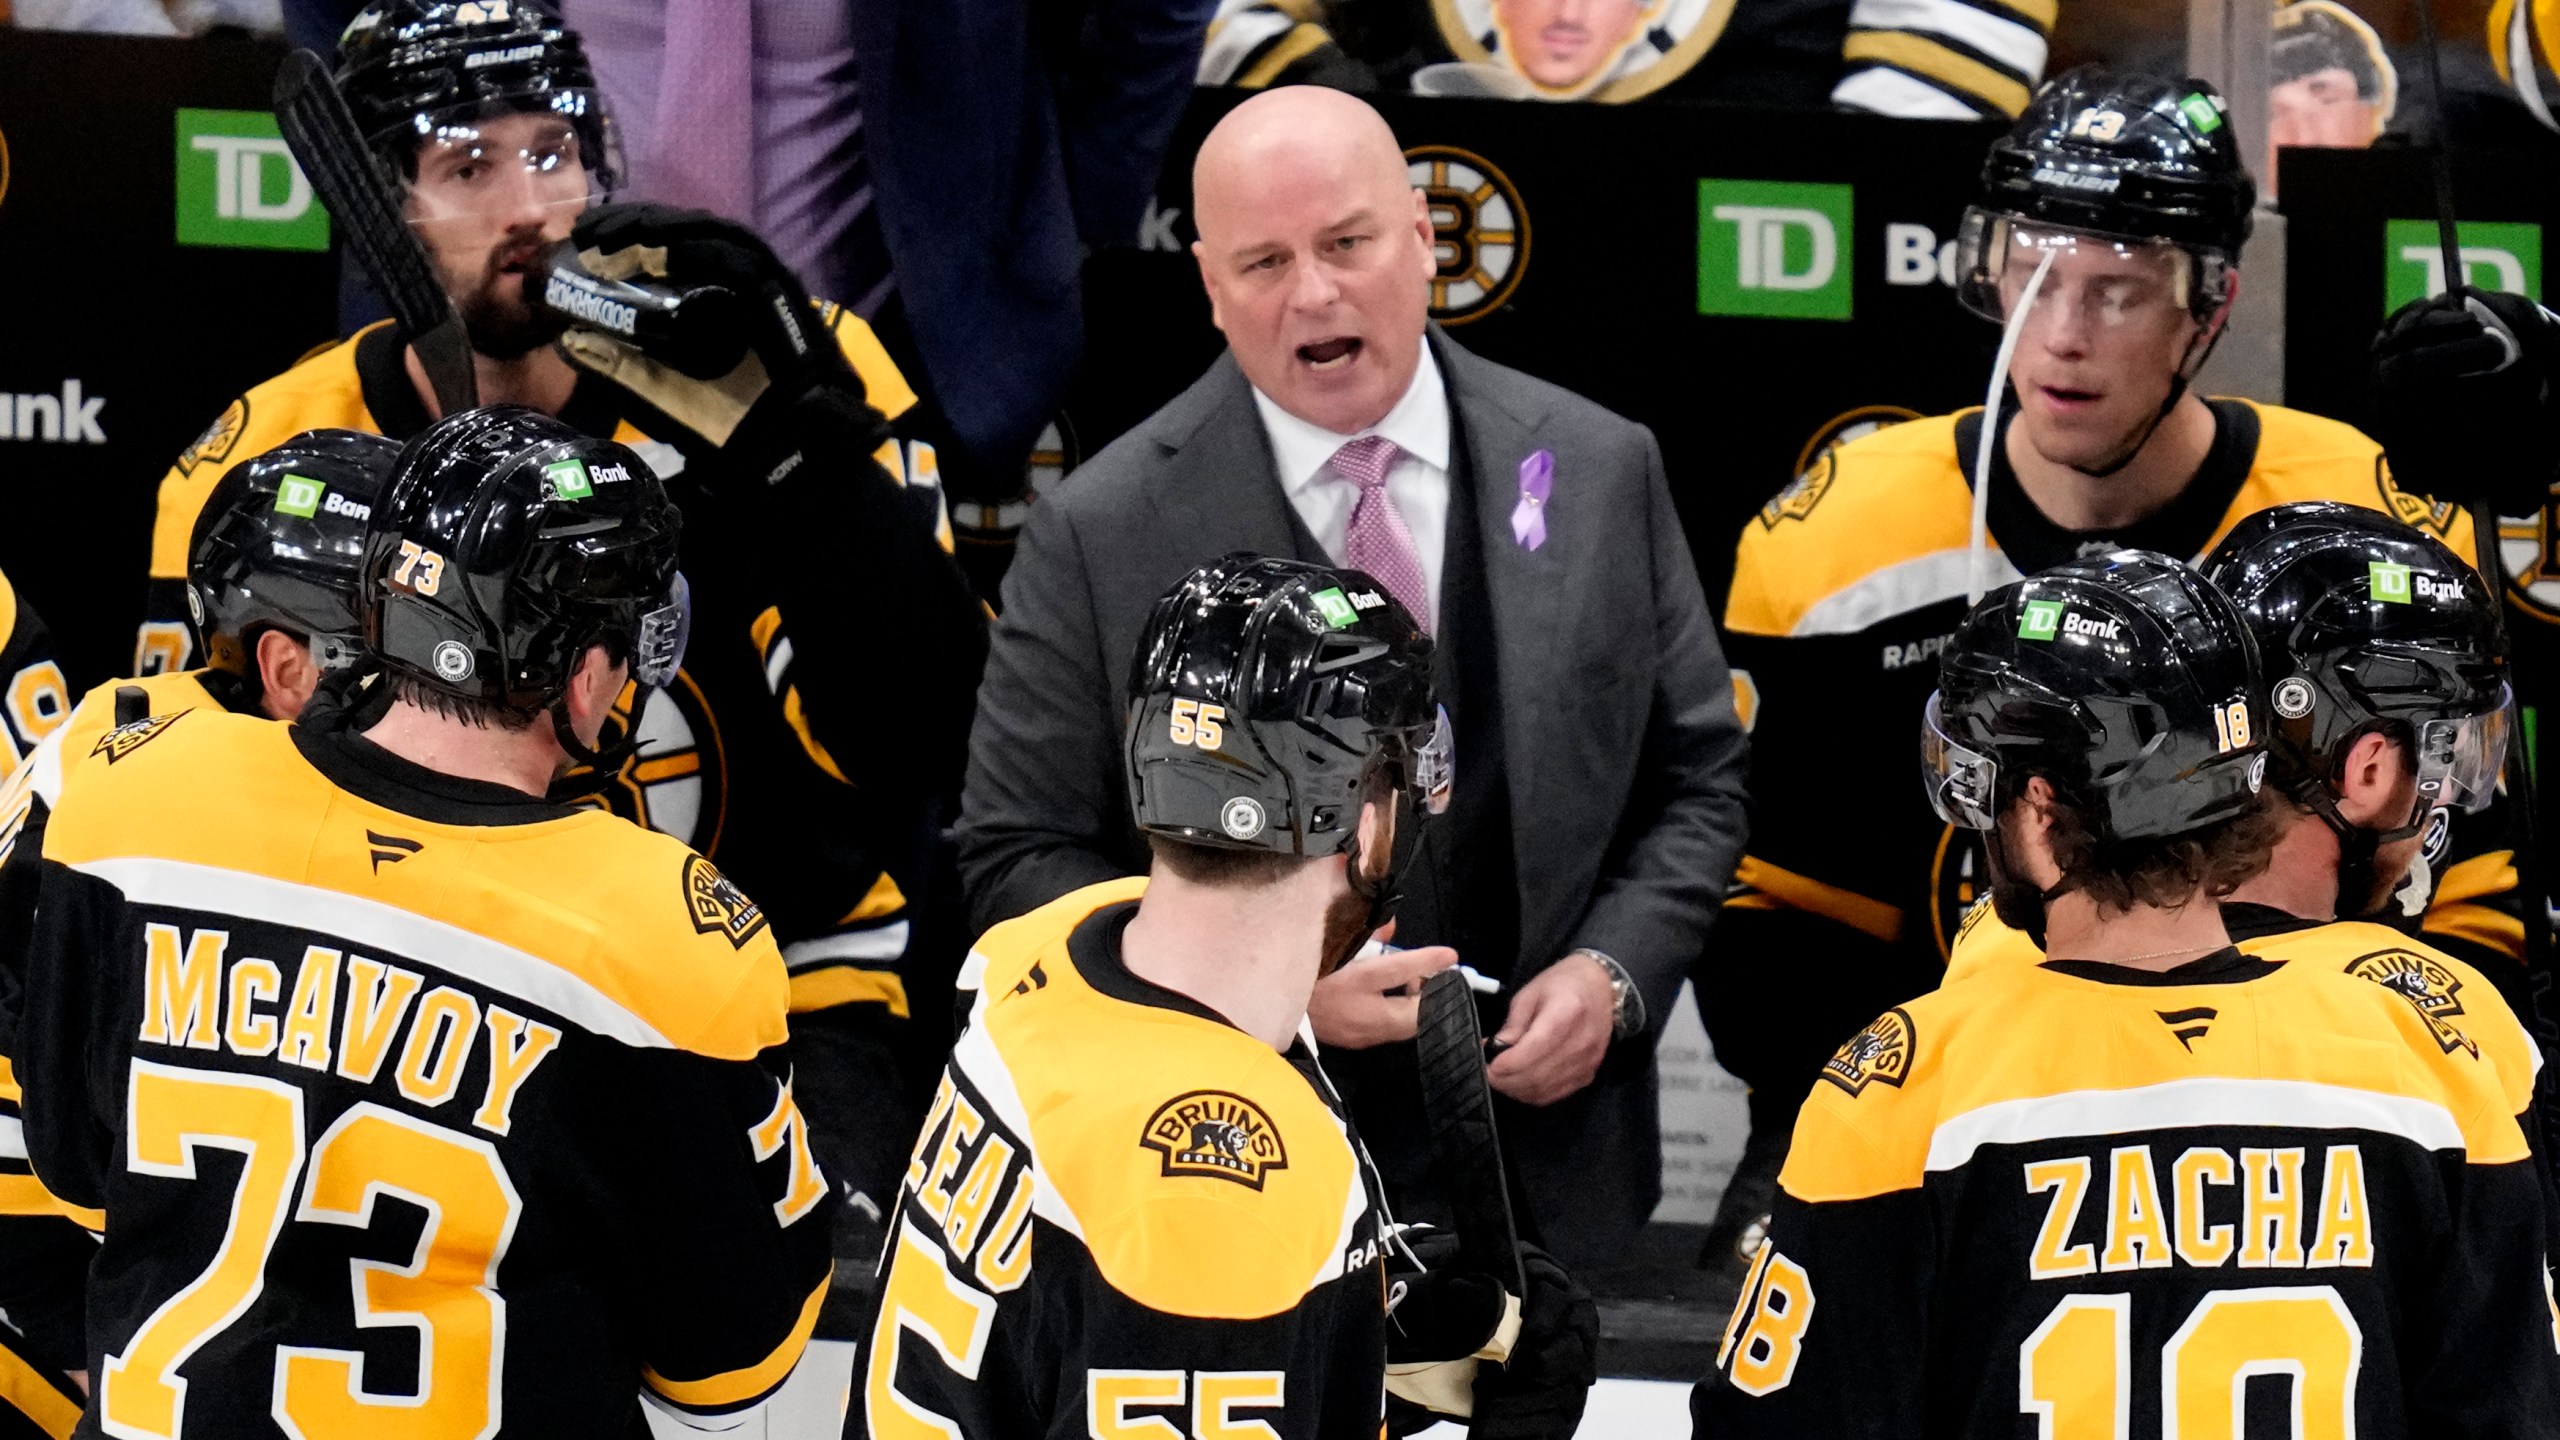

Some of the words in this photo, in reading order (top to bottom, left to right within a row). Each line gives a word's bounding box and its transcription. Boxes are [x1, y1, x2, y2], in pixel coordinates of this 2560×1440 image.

[464, 44, 546, 69] BAUER
[2070, 107, 2127, 142] 13
[191, 135, 313, 221] TD
[1713, 206, 1837, 291] TD
[545, 276, 638, 336] BODYARMOR
[283, 480, 317, 509] TD
[551, 466, 586, 492] TD
[588, 462, 632, 485] Bank
[394, 538, 446, 597] 73
[2372, 567, 2407, 596] TD
[2416, 575, 2466, 601] Bank
[1347, 588, 1387, 611] Bank
[2028, 606, 2057, 632] TD
[2063, 611, 2122, 641] Bank
[1170, 697, 1226, 751] 55
[2214, 702, 2251, 754] 18
[1155, 1101, 1274, 1157] BRUINS
[1182, 1153, 1249, 1172] BOSTON
[2024, 1145, 2374, 1280] ZACHA
[100, 1056, 524, 1440] 73
[1716, 1236, 1817, 1398] 18
